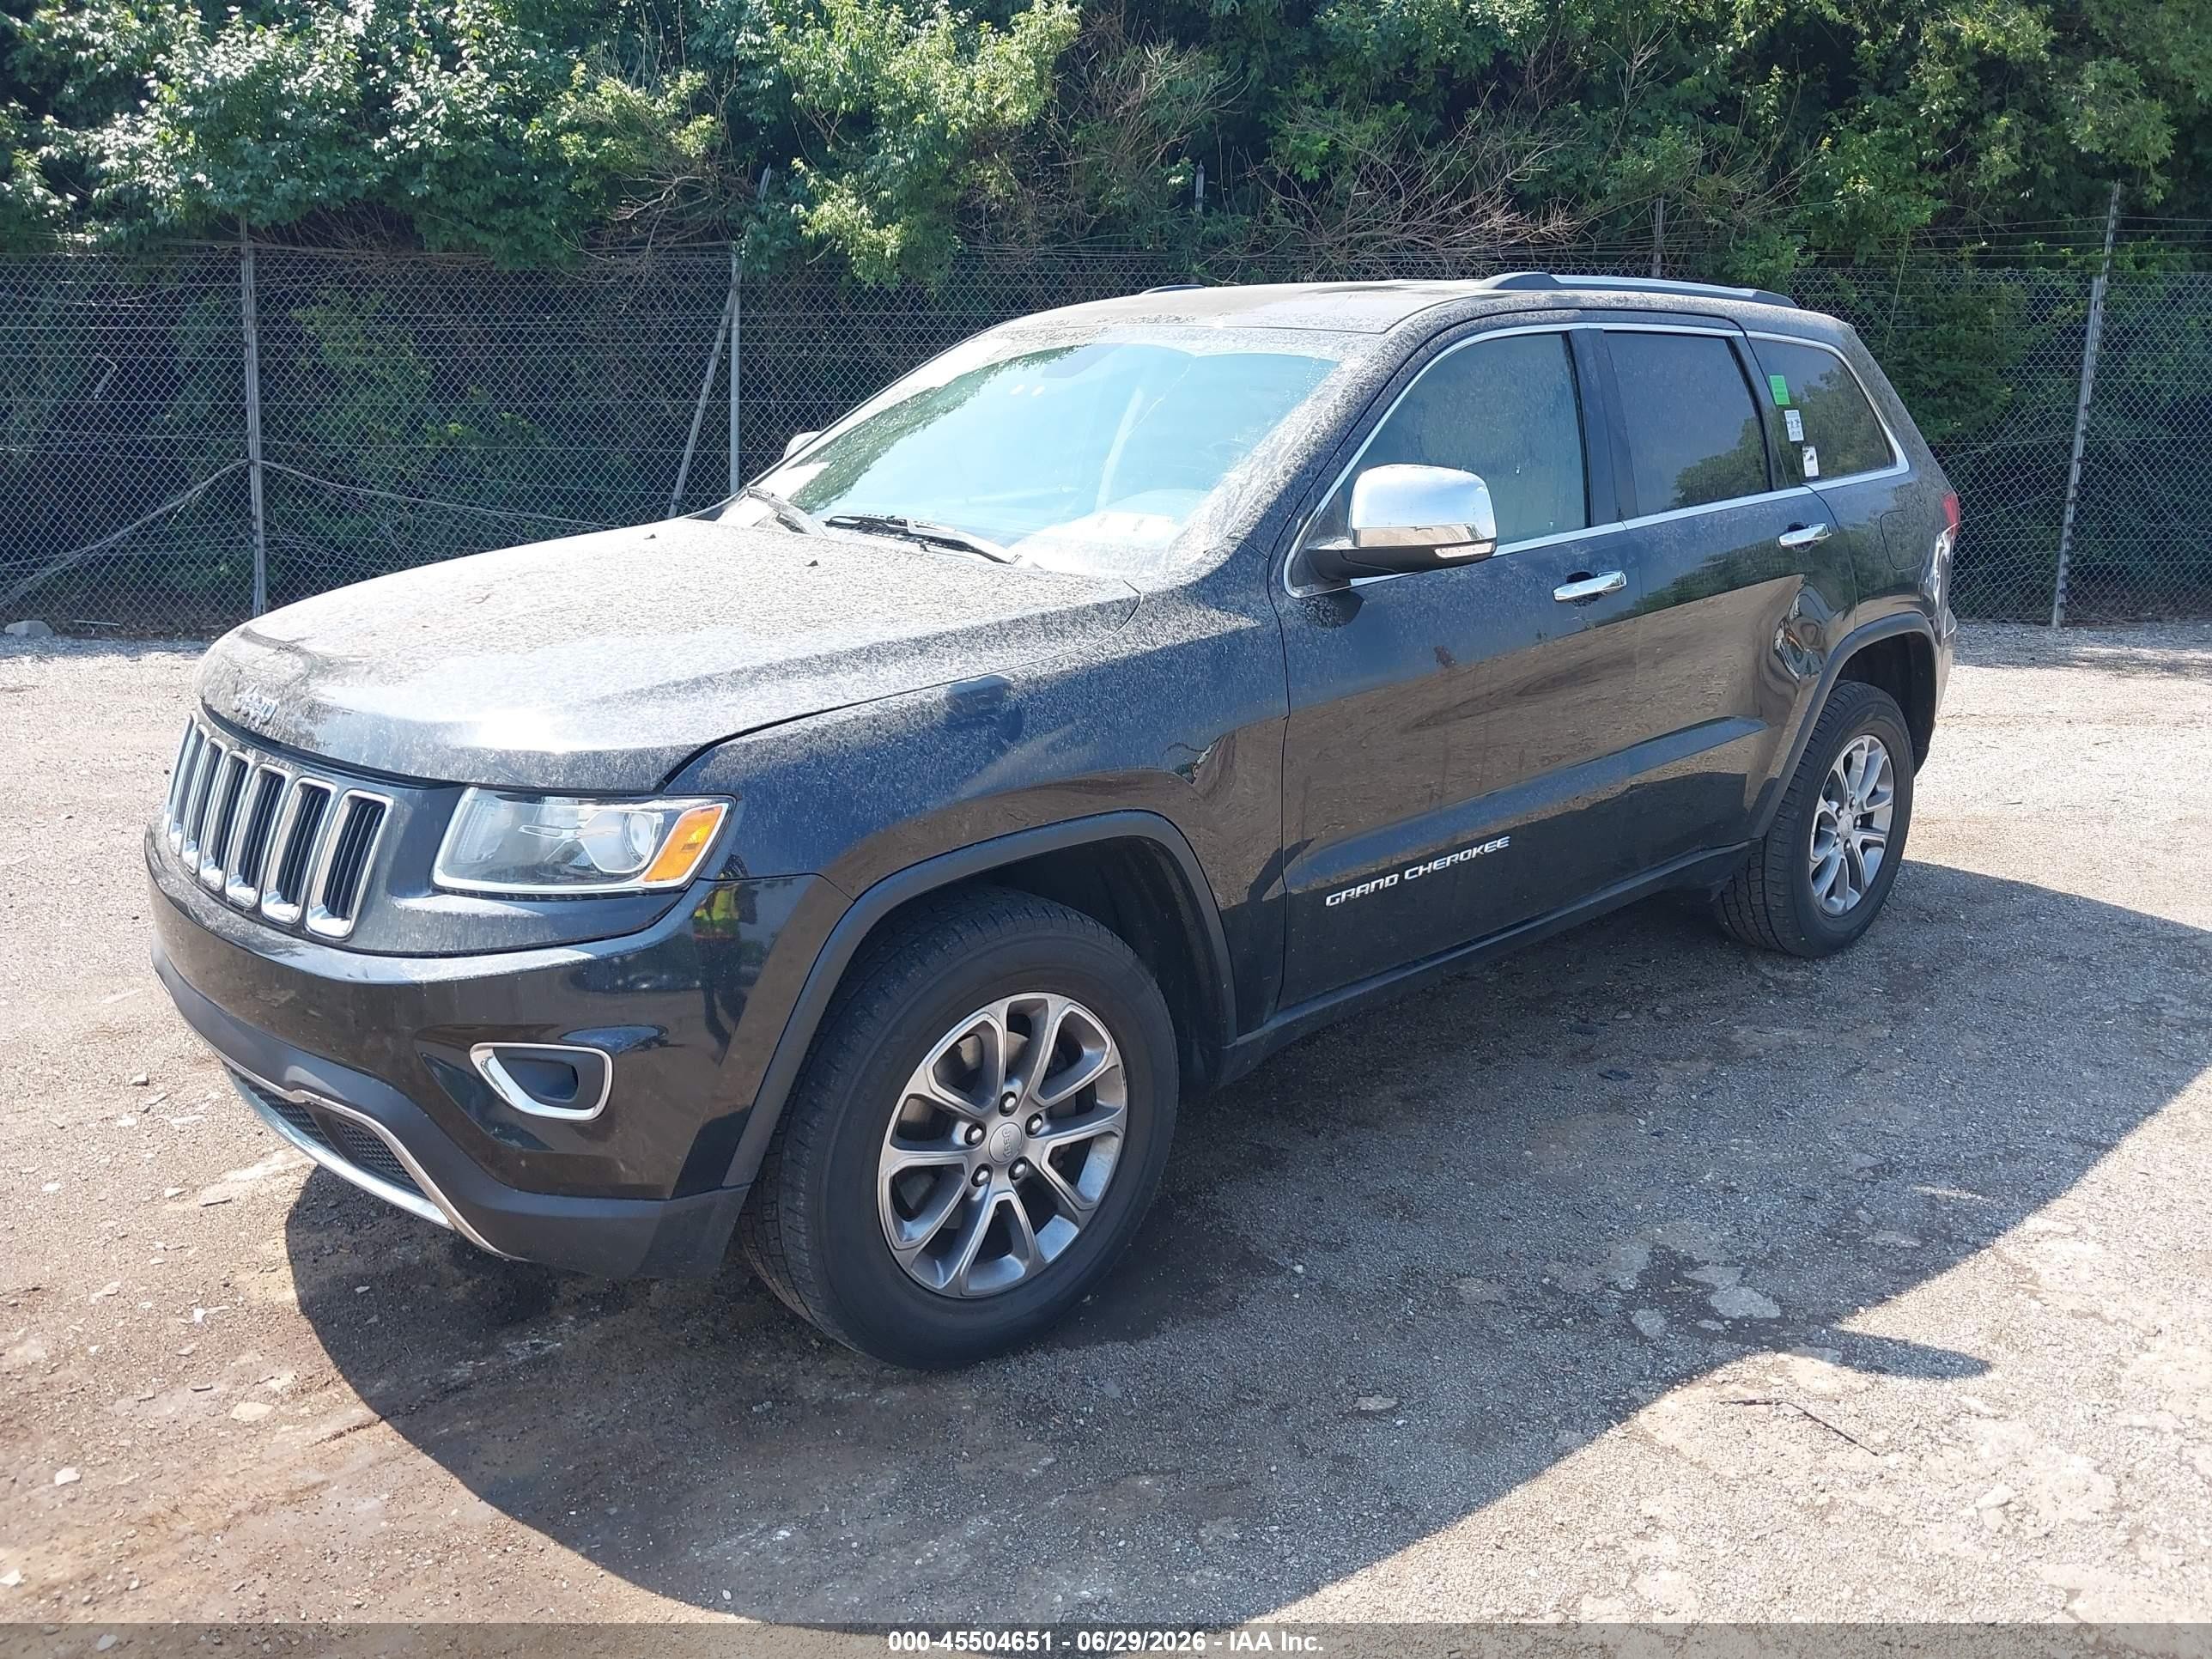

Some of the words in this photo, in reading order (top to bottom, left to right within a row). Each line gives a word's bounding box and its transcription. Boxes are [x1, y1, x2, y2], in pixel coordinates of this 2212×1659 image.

[1325, 874, 1401, 907] GRAND
[1404, 836, 1511, 880] CHEROKEE
[1002, 1127, 1012, 1158] Jeep
